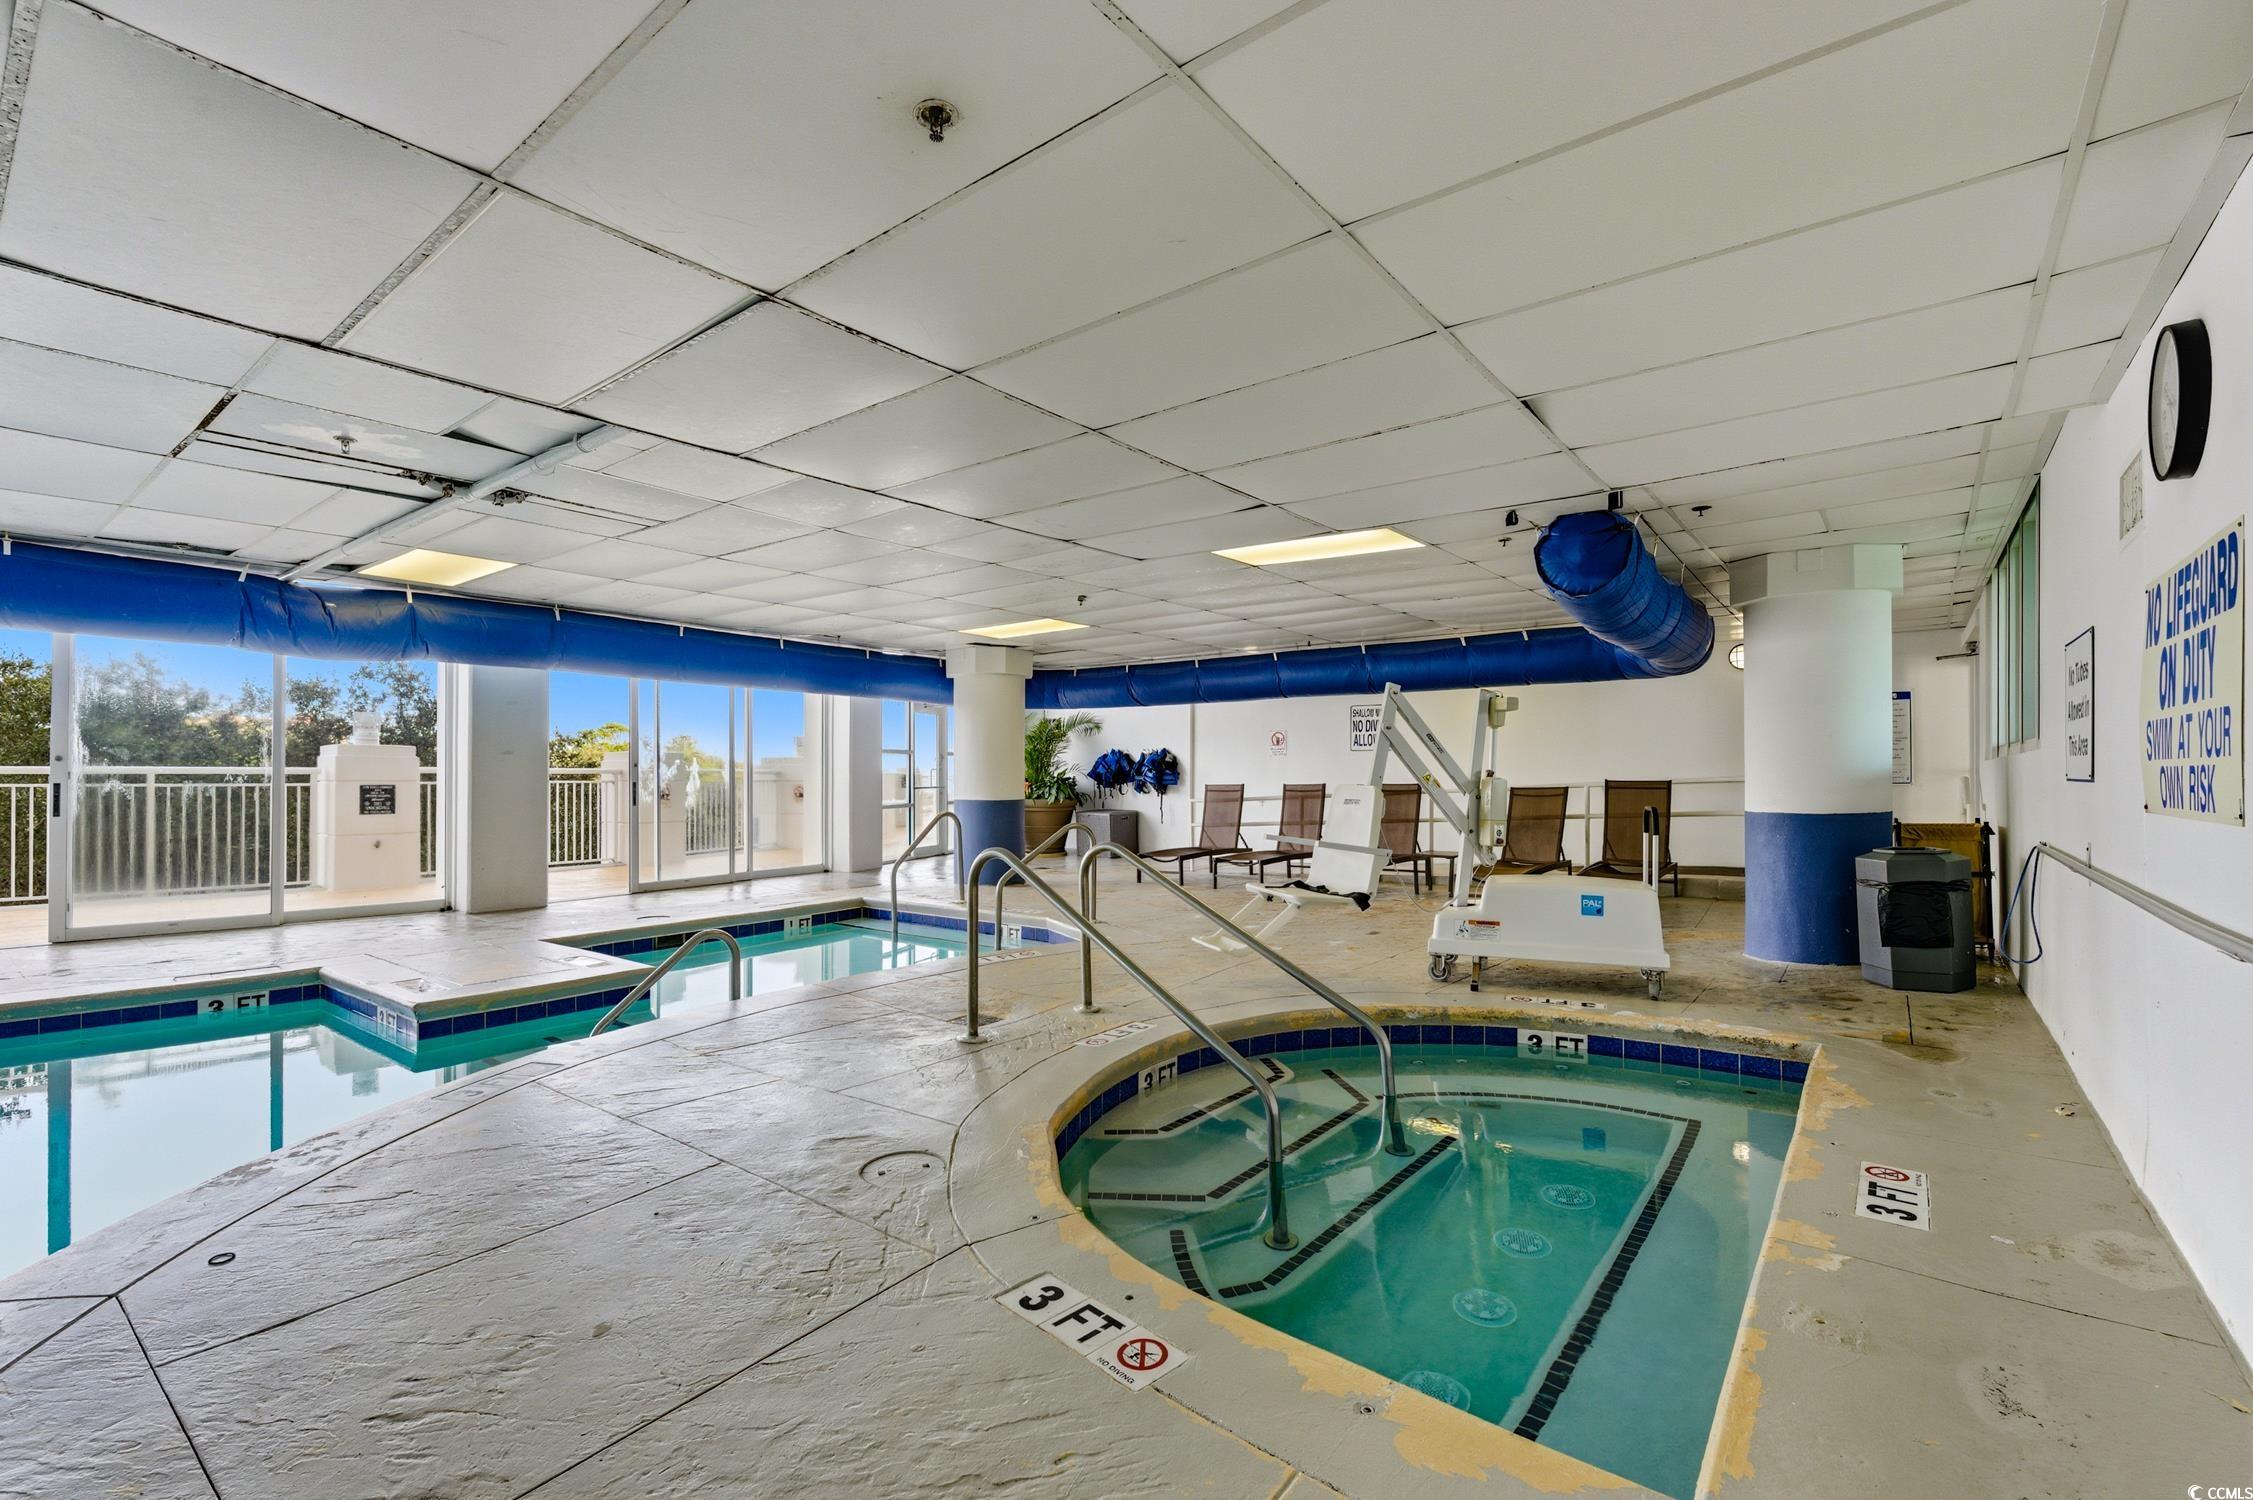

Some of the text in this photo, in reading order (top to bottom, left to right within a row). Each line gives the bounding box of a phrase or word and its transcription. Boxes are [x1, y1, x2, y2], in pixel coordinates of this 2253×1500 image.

[2145, 531, 2238, 649] NO LIFEGUARD
[2159, 625, 2216, 711] ON DUTY
[1353, 719, 1379, 733] NO DIV
[1353, 733, 1376, 747] ALLO
[2146, 705, 2231, 762] SWIM AT YOUR
[2160, 764, 2216, 814] OWN RISK
[237, 994, 266, 1009] FT
[1556, 1035, 1584, 1052] FT
[1144, 1061, 1176, 1090] 3 FT
[1866, 1181, 1919, 1221] 3 FT
[1019, 1286, 1127, 1344] 3 FT
[1096, 1356, 1136, 1385] NO DIVING
